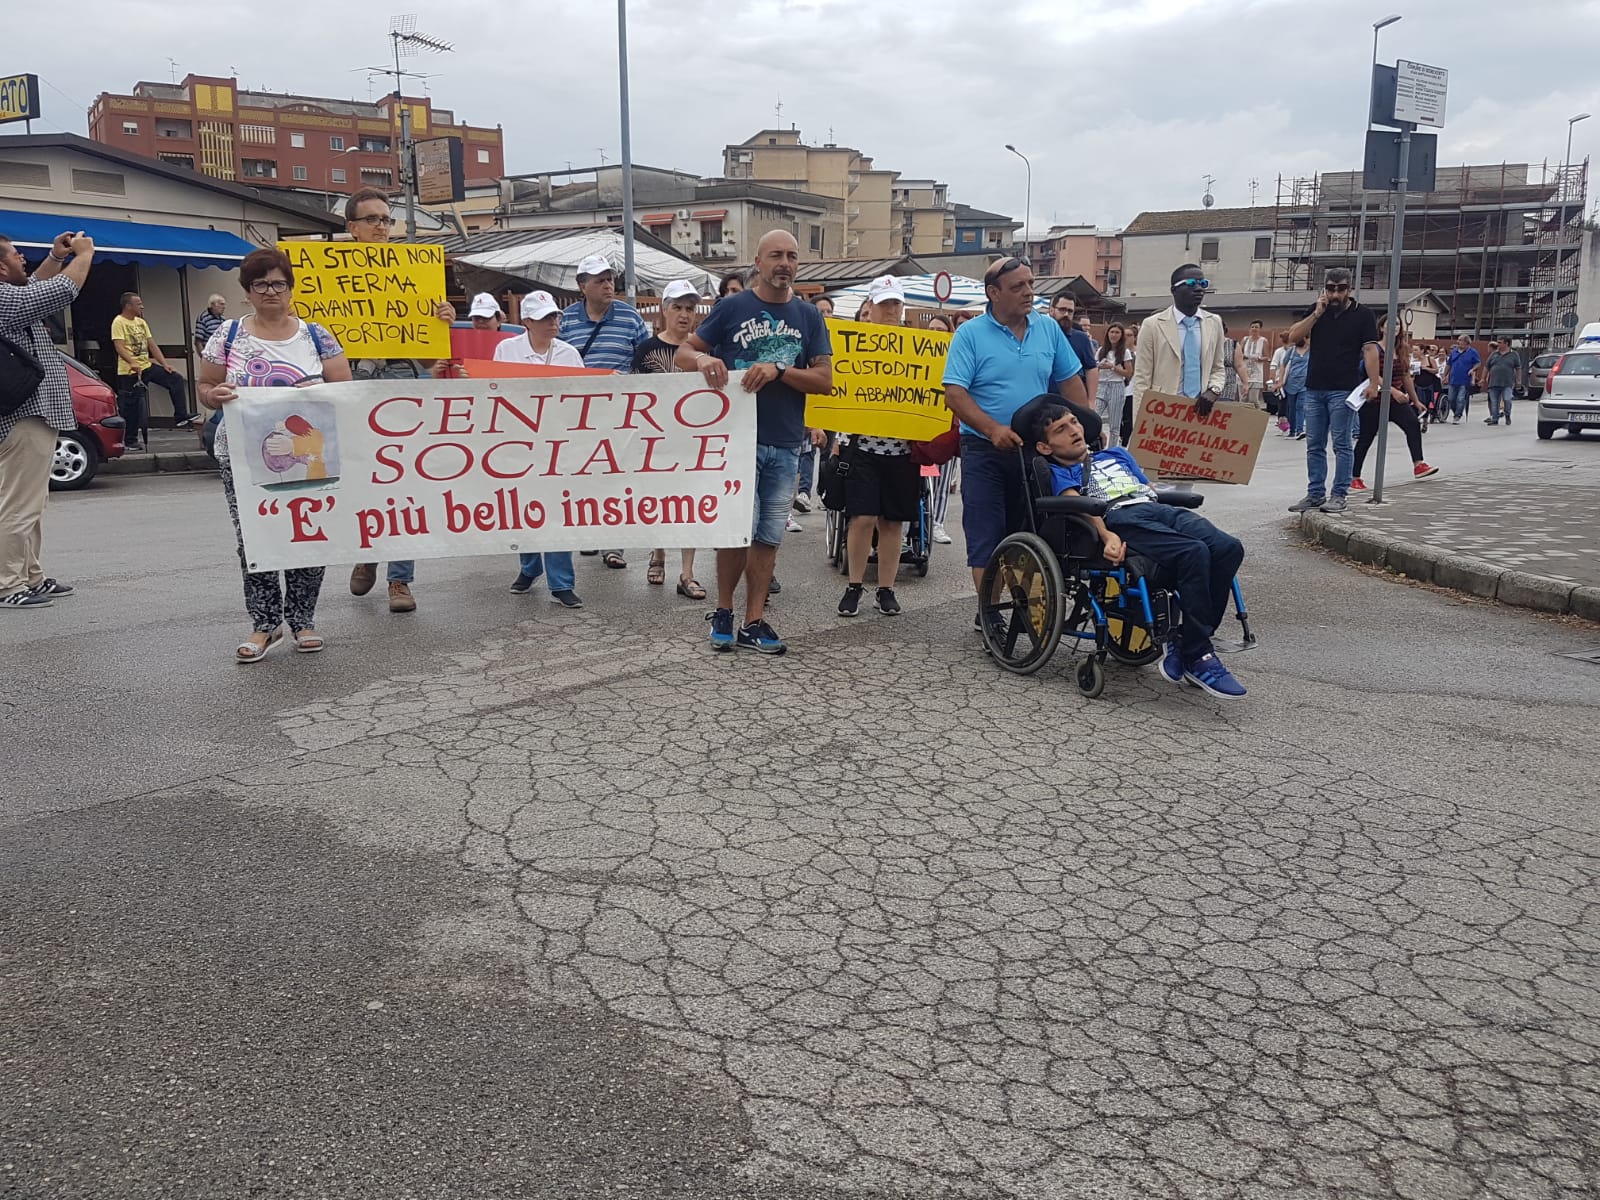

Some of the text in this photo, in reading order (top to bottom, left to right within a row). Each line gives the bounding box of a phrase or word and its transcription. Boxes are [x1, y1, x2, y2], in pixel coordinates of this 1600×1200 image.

[285, 247, 442, 268] LA STORIA NON
[300, 273, 418, 294] SI FERMA
[293, 295, 443, 319] DAVANTI AD UN
[330, 322, 430, 348] PORTONE
[837, 330, 904, 355] TESORI
[834, 359, 930, 381] CUSTODITI
[830, 381, 848, 399] ON
[367, 388, 732, 438] CENTRO
[370, 433, 731, 485] SOCIALE
[1137, 438, 1188, 459] LIBERARE
[355, 496, 430, 550] più
[444, 486, 546, 535] bello
